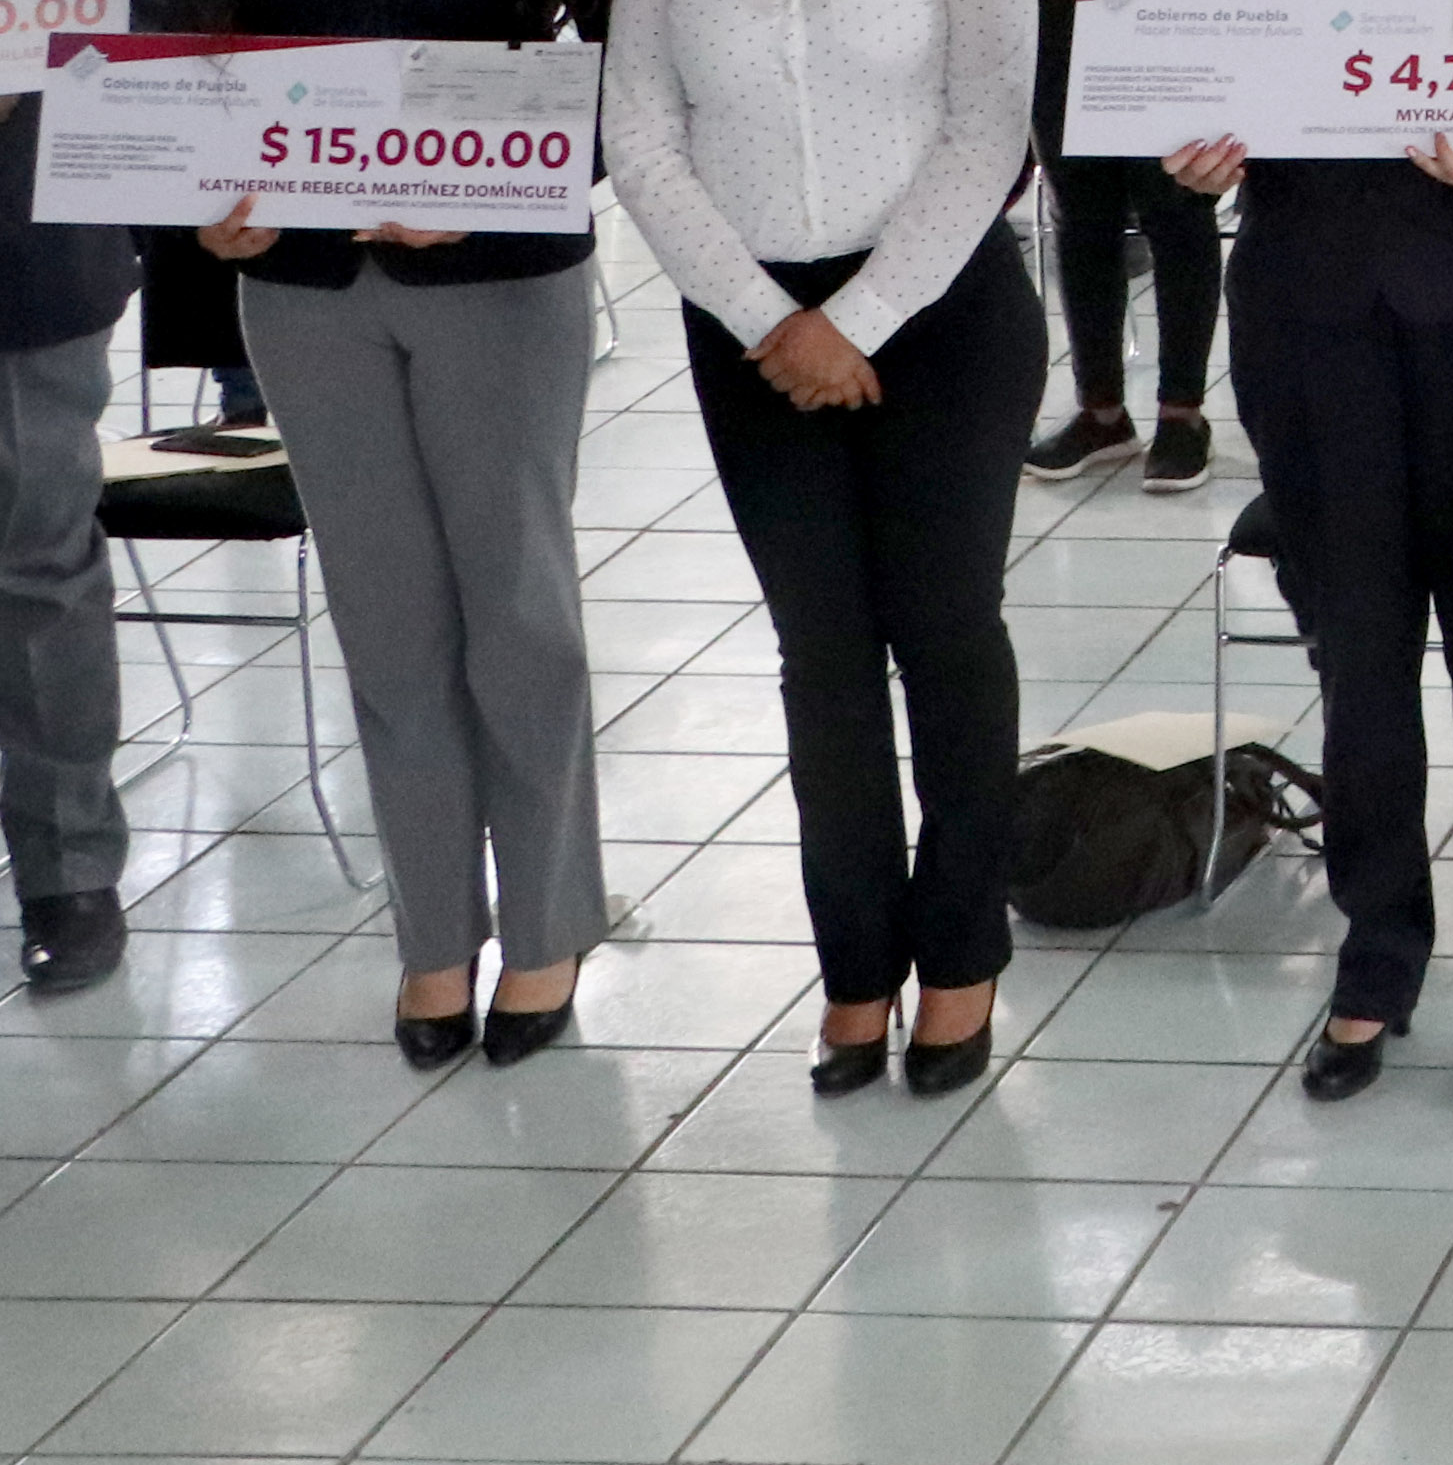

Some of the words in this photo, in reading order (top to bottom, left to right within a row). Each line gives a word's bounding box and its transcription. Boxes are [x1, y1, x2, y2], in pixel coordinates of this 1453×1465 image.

[1136, 8, 1208, 22] Gobierno
[1212, 8, 1232, 22] de
[1236, 9, 1289, 22] Puebla
[1343, 49, 1374, 97] $
[260, 120, 289, 168] $
[305, 127, 571, 172] 15,000.00
[199, 178, 297, 193] KATHERINE
[301, 180, 367, 195] REBECA
[371, 180, 460, 197] MARTÍNEZ
[464, 181, 568, 199] DOMÍNGUEZ
